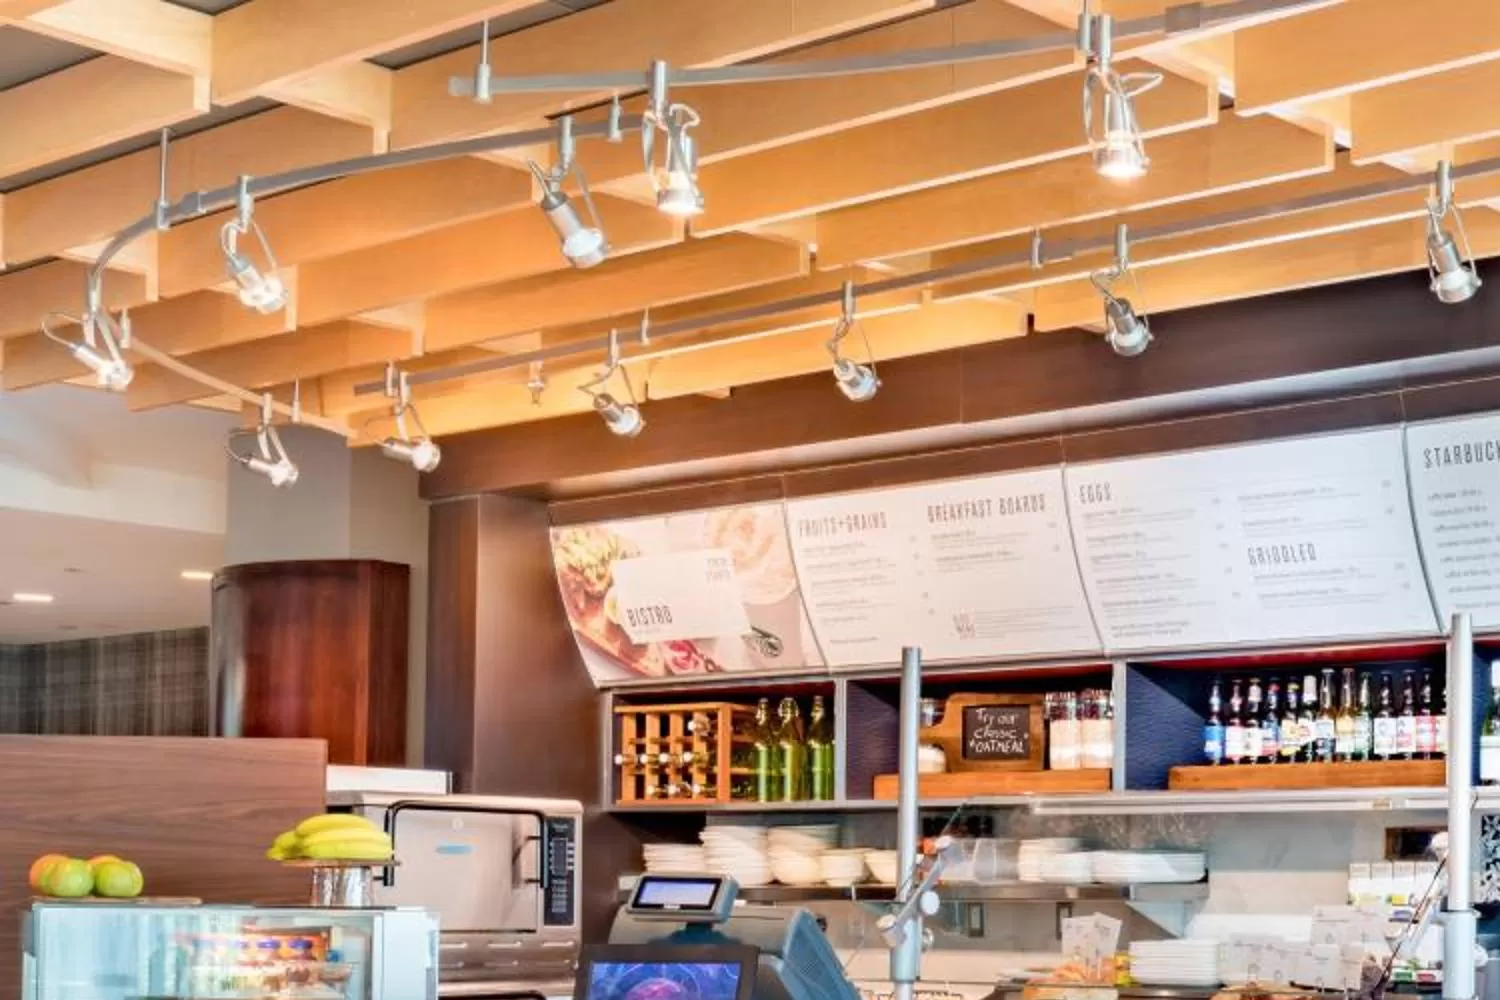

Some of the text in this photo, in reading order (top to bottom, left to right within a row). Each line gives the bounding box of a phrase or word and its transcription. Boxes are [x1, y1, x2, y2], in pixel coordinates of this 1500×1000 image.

[1078, 483, 1112, 505] EGGS
[927, 493, 1047, 523] BREAKFAST BOARDS
[1247, 543, 1317, 566] GRIDDLED
[626, 605, 673, 628] BISTRO
